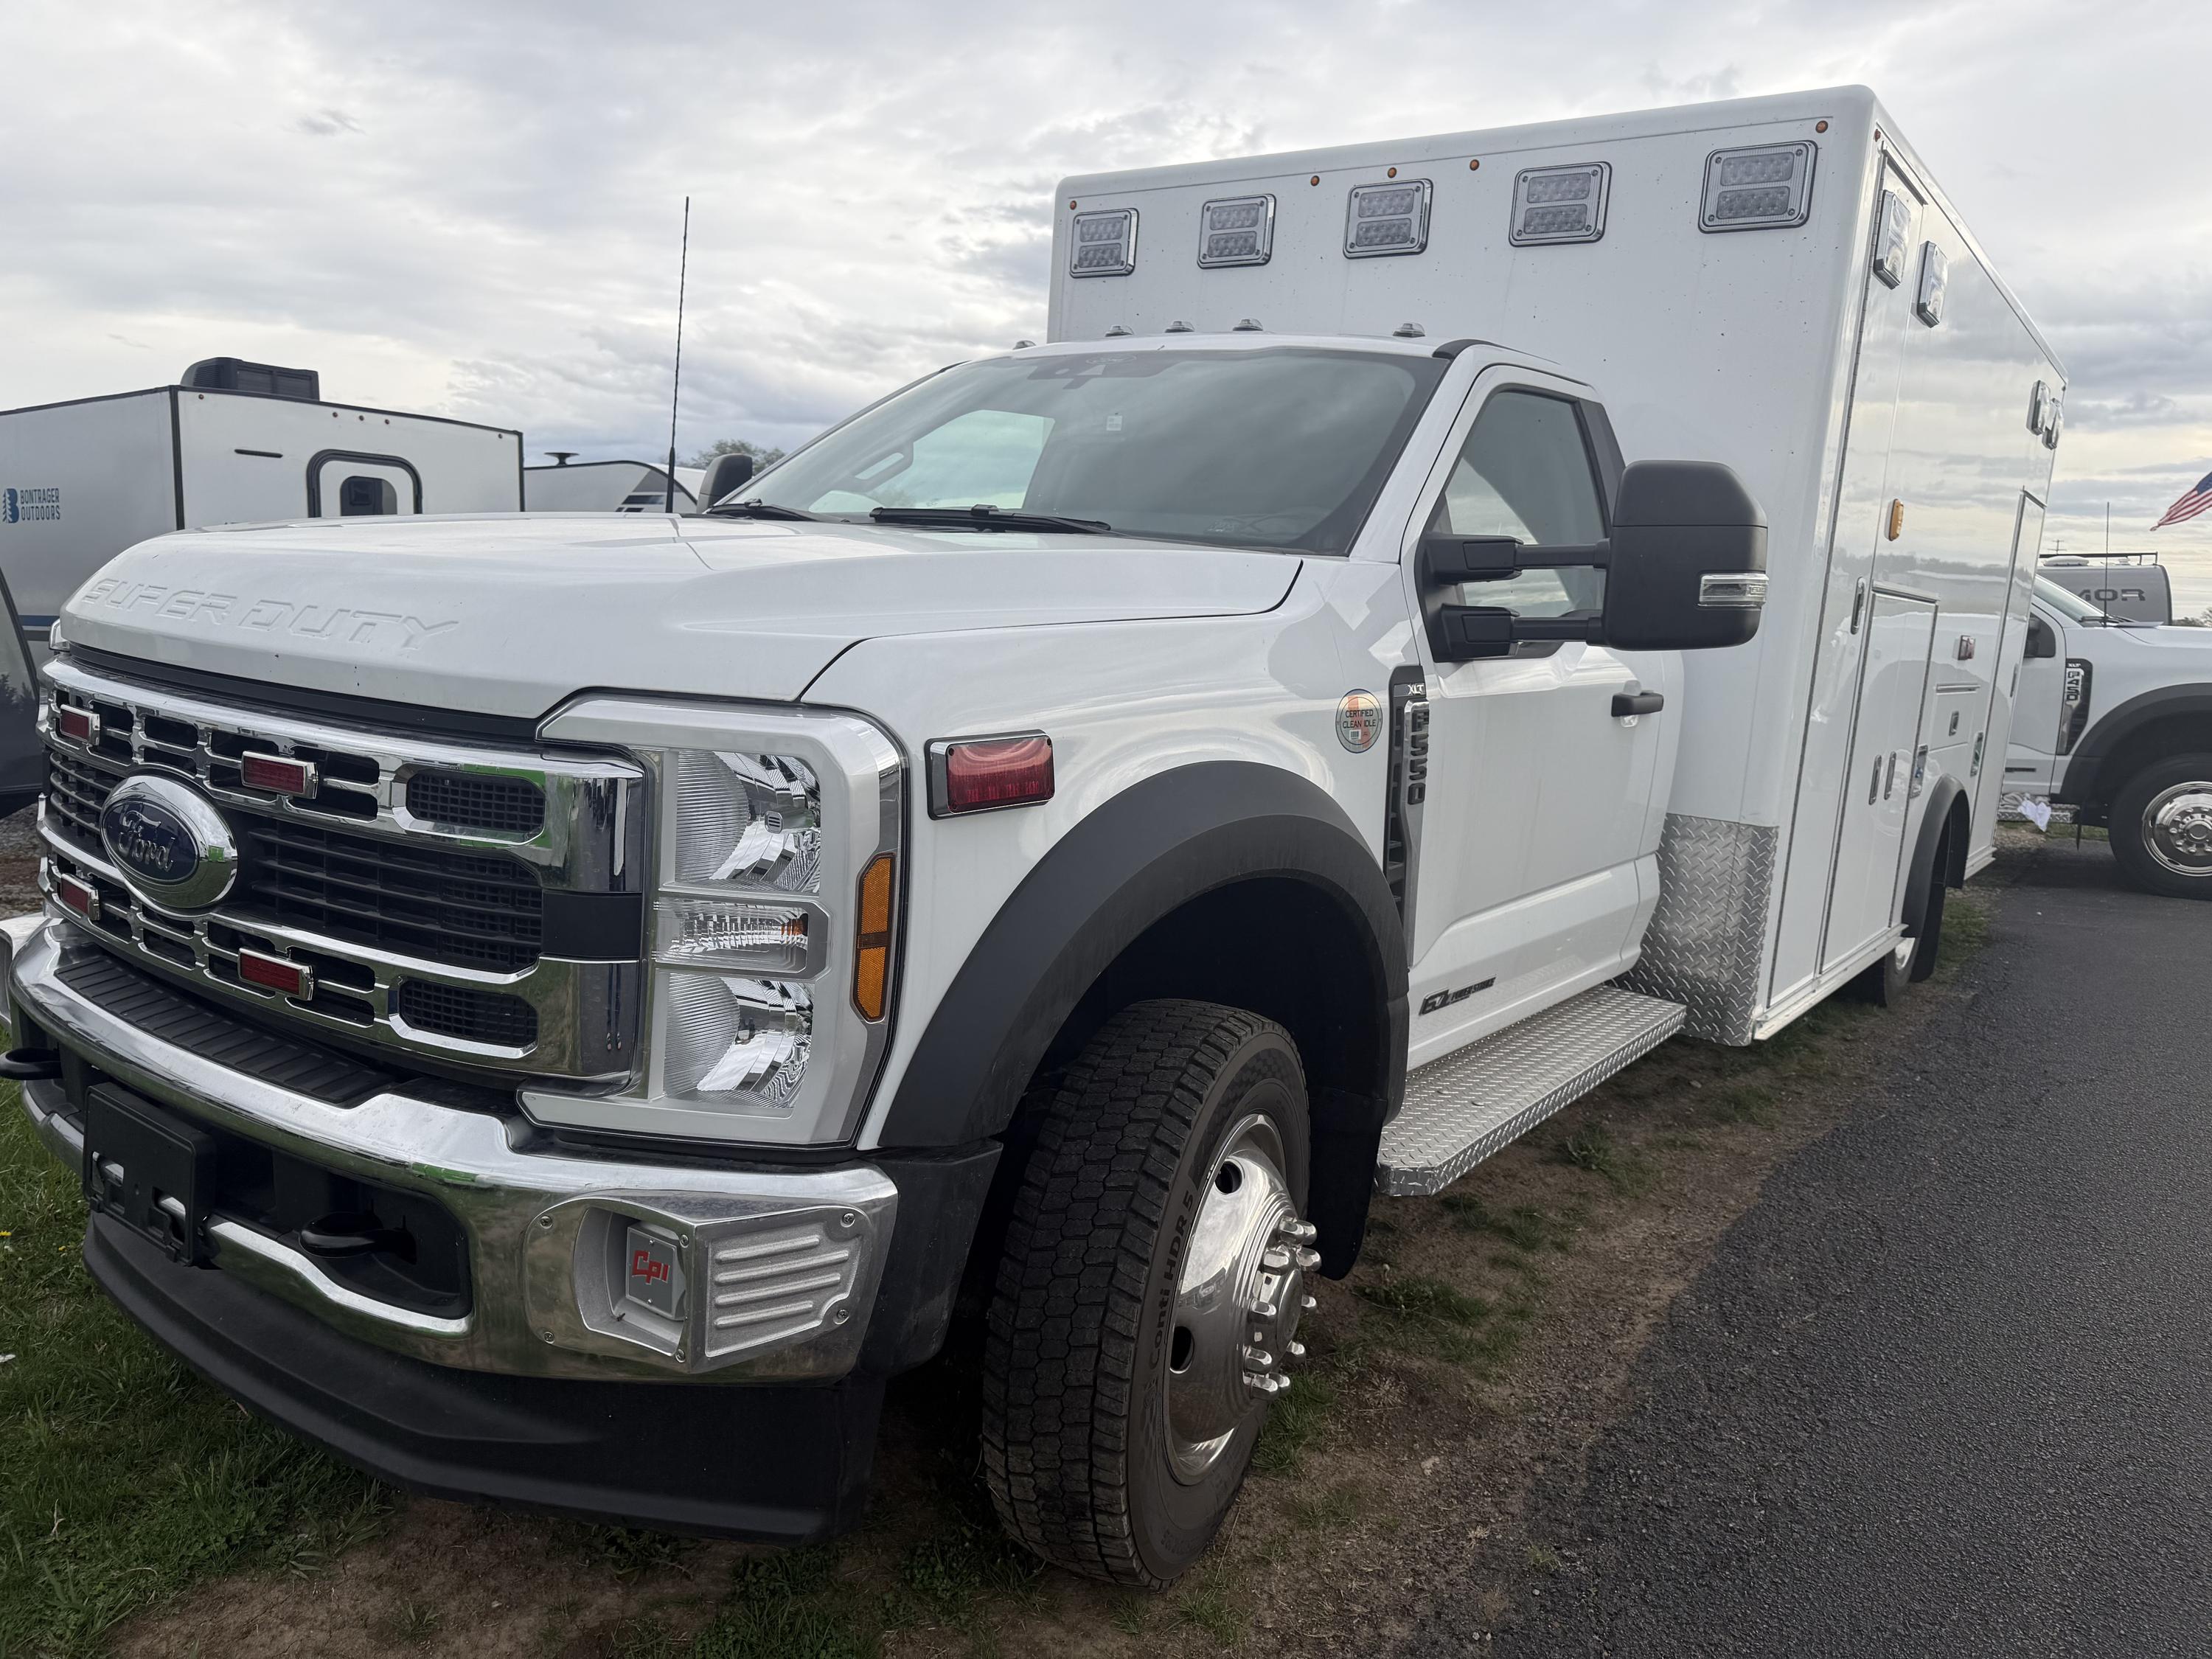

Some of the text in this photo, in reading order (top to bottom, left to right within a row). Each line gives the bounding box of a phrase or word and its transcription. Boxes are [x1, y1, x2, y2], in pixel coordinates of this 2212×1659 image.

[20, 487, 60, 504] BONTRAGER
[21, 504, 60, 521] OUTDOORS
[81, 577, 459, 650] SUPER DUTY
[1407, 684, 1425, 695] XLT
[1345, 709, 1374, 718] CERTIFIED
[1342, 719, 1377, 728] CLEAN IDLE
[1407, 709, 1430, 805] F550
[118, 809, 176, 872] Ford
[1149, 1190, 1194, 1370] Conti HDR 5
